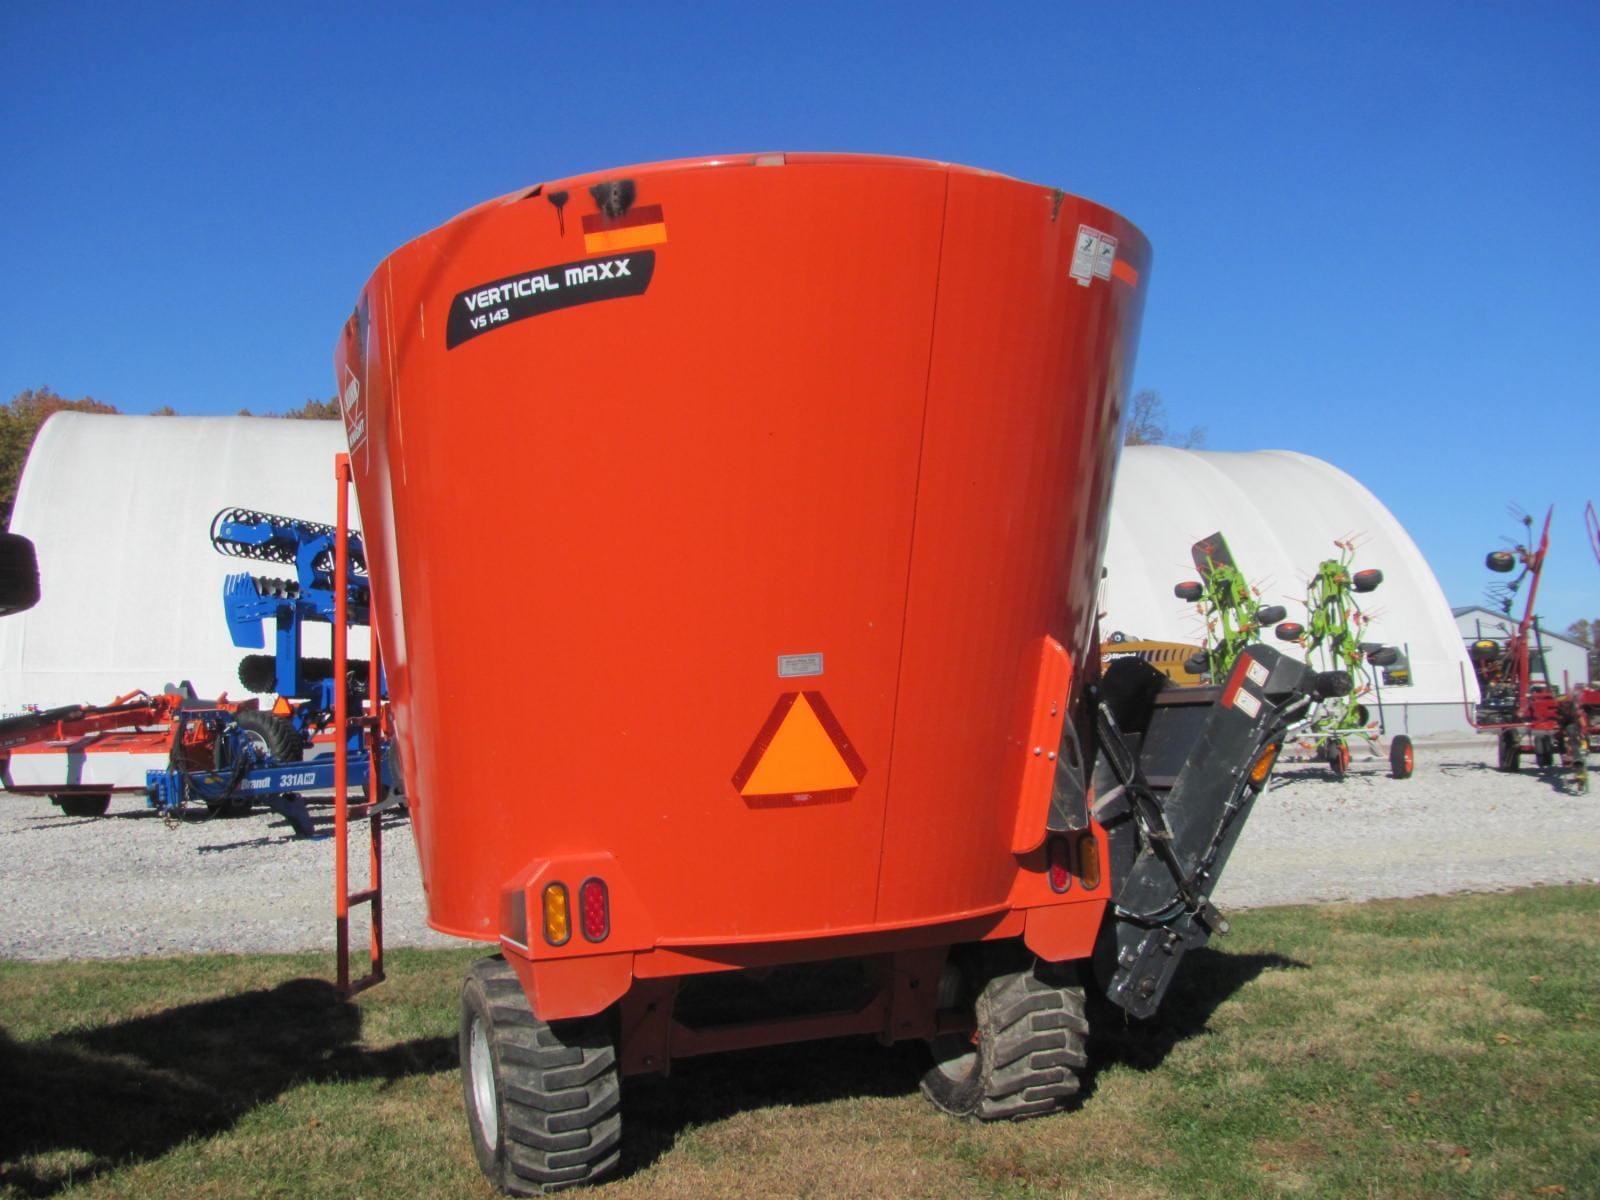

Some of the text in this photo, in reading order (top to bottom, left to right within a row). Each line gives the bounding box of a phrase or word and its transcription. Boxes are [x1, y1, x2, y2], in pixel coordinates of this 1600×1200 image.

[464, 258, 631, 312] VERTICAL MAXX
[470, 308, 510, 330] VS 143
[241, 776, 271, 790] Brandt
